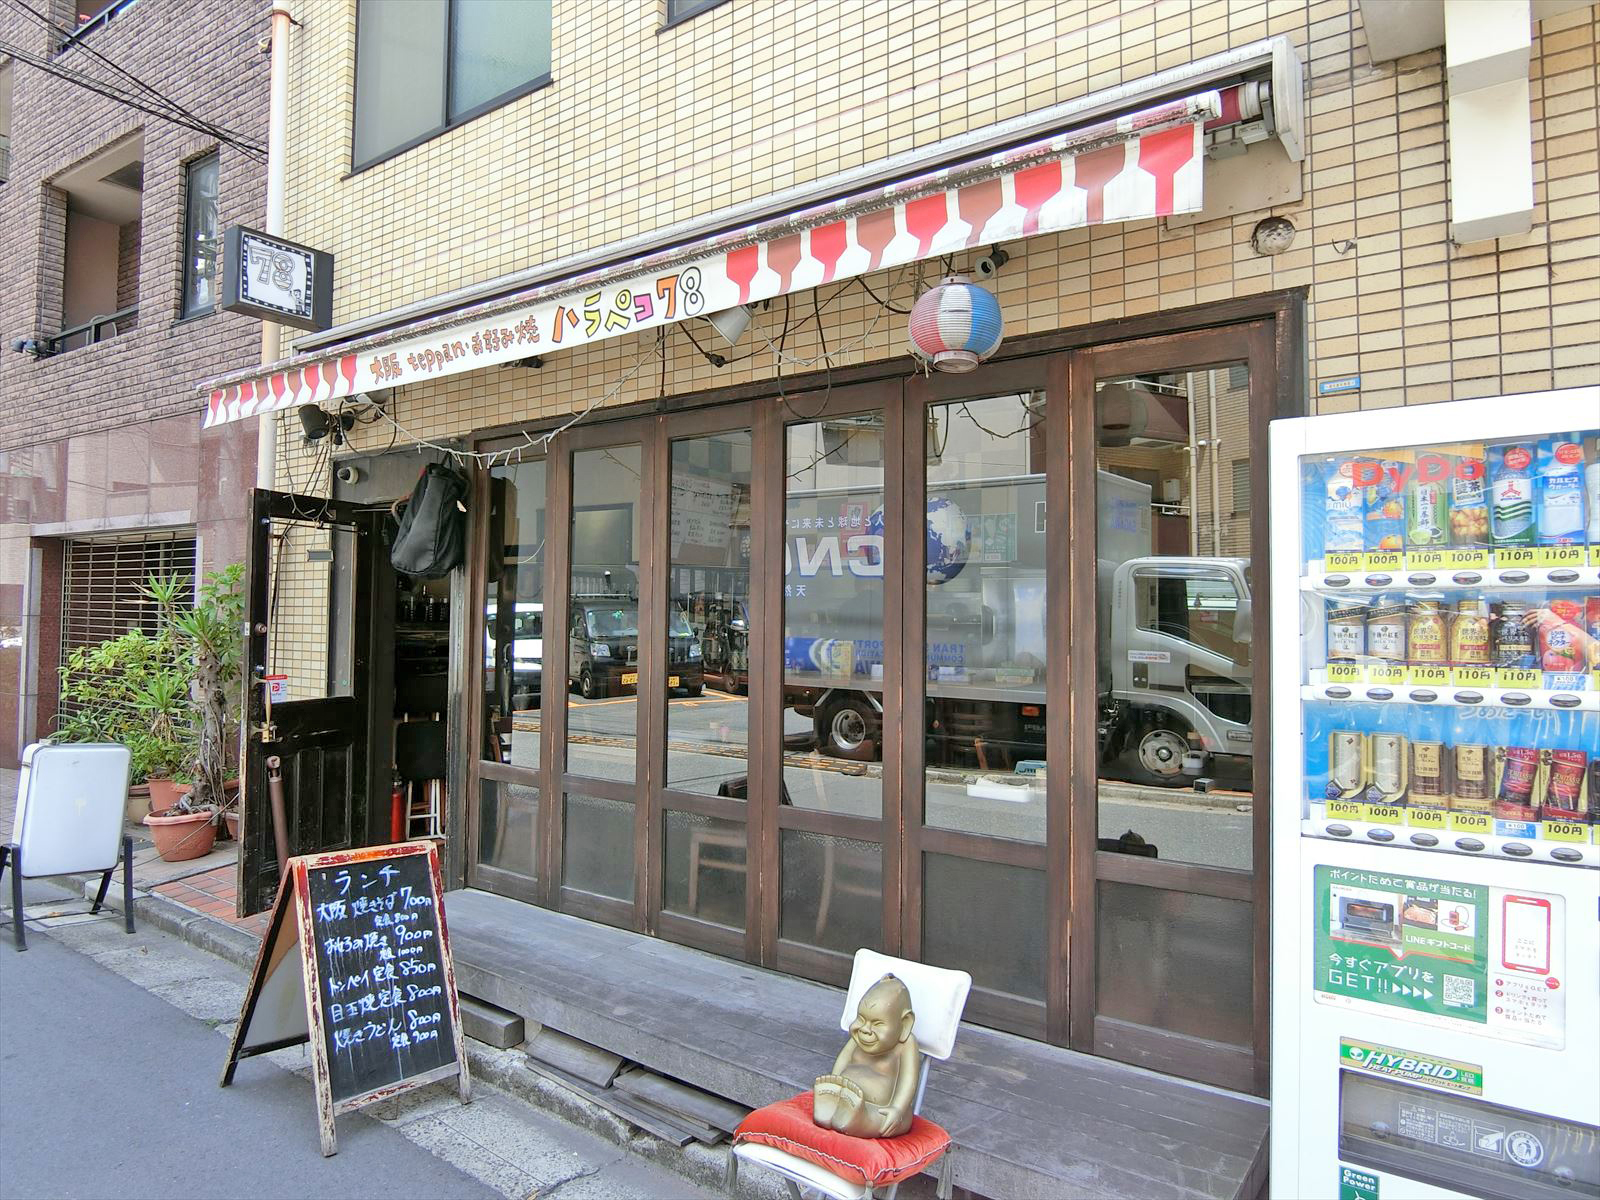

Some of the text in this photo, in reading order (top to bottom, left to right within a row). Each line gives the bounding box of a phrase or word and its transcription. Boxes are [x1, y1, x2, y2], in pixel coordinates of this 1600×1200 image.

[248, 246, 295, 291] 78
[370, 352, 402, 384] 大阪
[1352, 456, 1486, 494] DyDo
[1329, 554, 1359, 565] 100円
[1369, 553, 1398, 565] 100円
[1411, 553, 1442, 564] 110円
[1452, 552, 1483, 562] 100円
[1500, 551, 1533, 561] 110円
[1545, 550, 1579, 560] 110円
[1415, 669, 1445, 678] 110円
[1459, 670, 1490, 680] 110円
[1330, 803, 1359, 813] 100円
[1369, 808, 1398, 817] 100円
[1411, 811, 1442, 821] 100円
[1455, 816, 1487, 826] 100円
[1548, 824, 1582, 835] 100円
[335, 864, 400, 895] ランチ
[316, 886, 432, 922] 大阪 焼きそば 700円
[394, 912, 418, 923] 800円
[395, 924, 432, 945] 900円
[398, 946, 423, 956] 1000円
[373, 963, 399, 982] 定食
[399, 958, 436, 974] 850円
[1328, 952, 1434, 984] 今すぐアプリを
[1328, 968, 1388, 994] GET!!
[378, 987, 407, 1008] 定食
[407, 984, 441, 1001] 800円
[334, 1009, 441, 1052] 焼きうどん 800円
[412, 1029, 438, 1043] 900円
[1361, 1050, 1459, 1081] HYBRID
[1343, 1169, 1375, 1184] Green
[1343, 1175, 1376, 1191] Power
